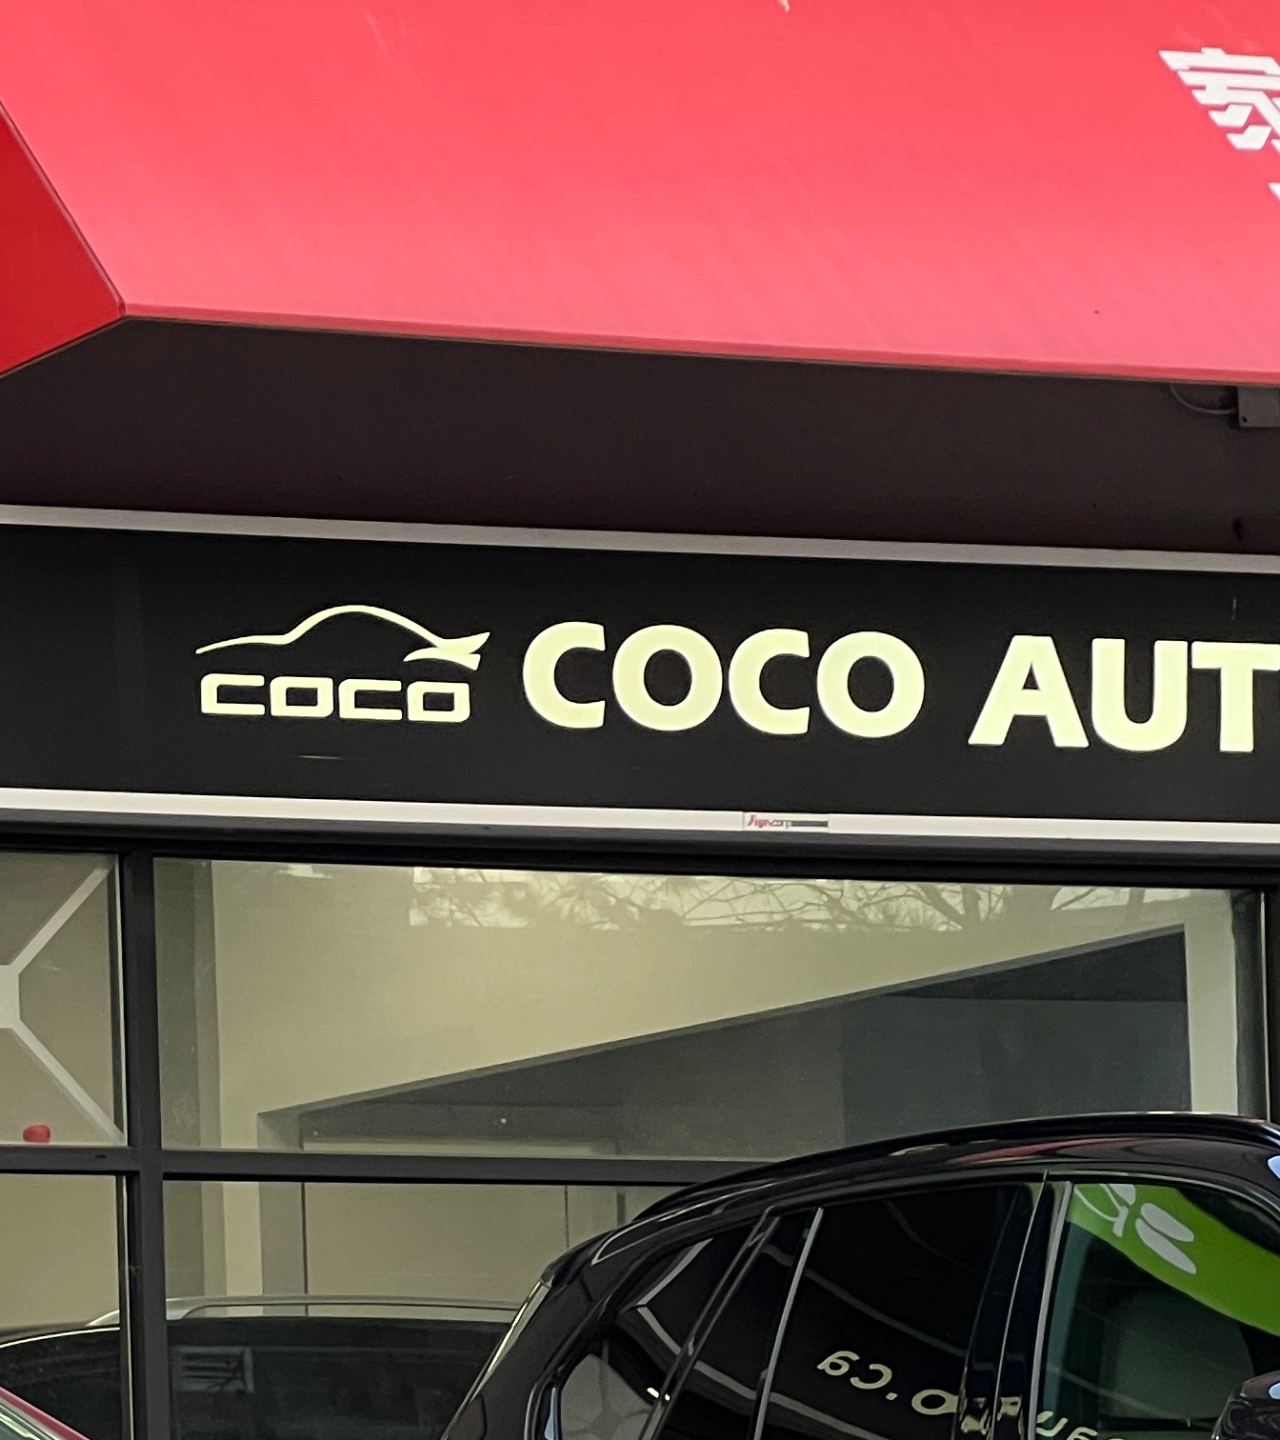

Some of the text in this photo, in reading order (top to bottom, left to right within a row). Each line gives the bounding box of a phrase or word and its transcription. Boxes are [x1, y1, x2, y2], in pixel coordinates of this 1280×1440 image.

[201, 673, 471, 722] COCO
[522, 621, 1280, 753] COCO AUT
